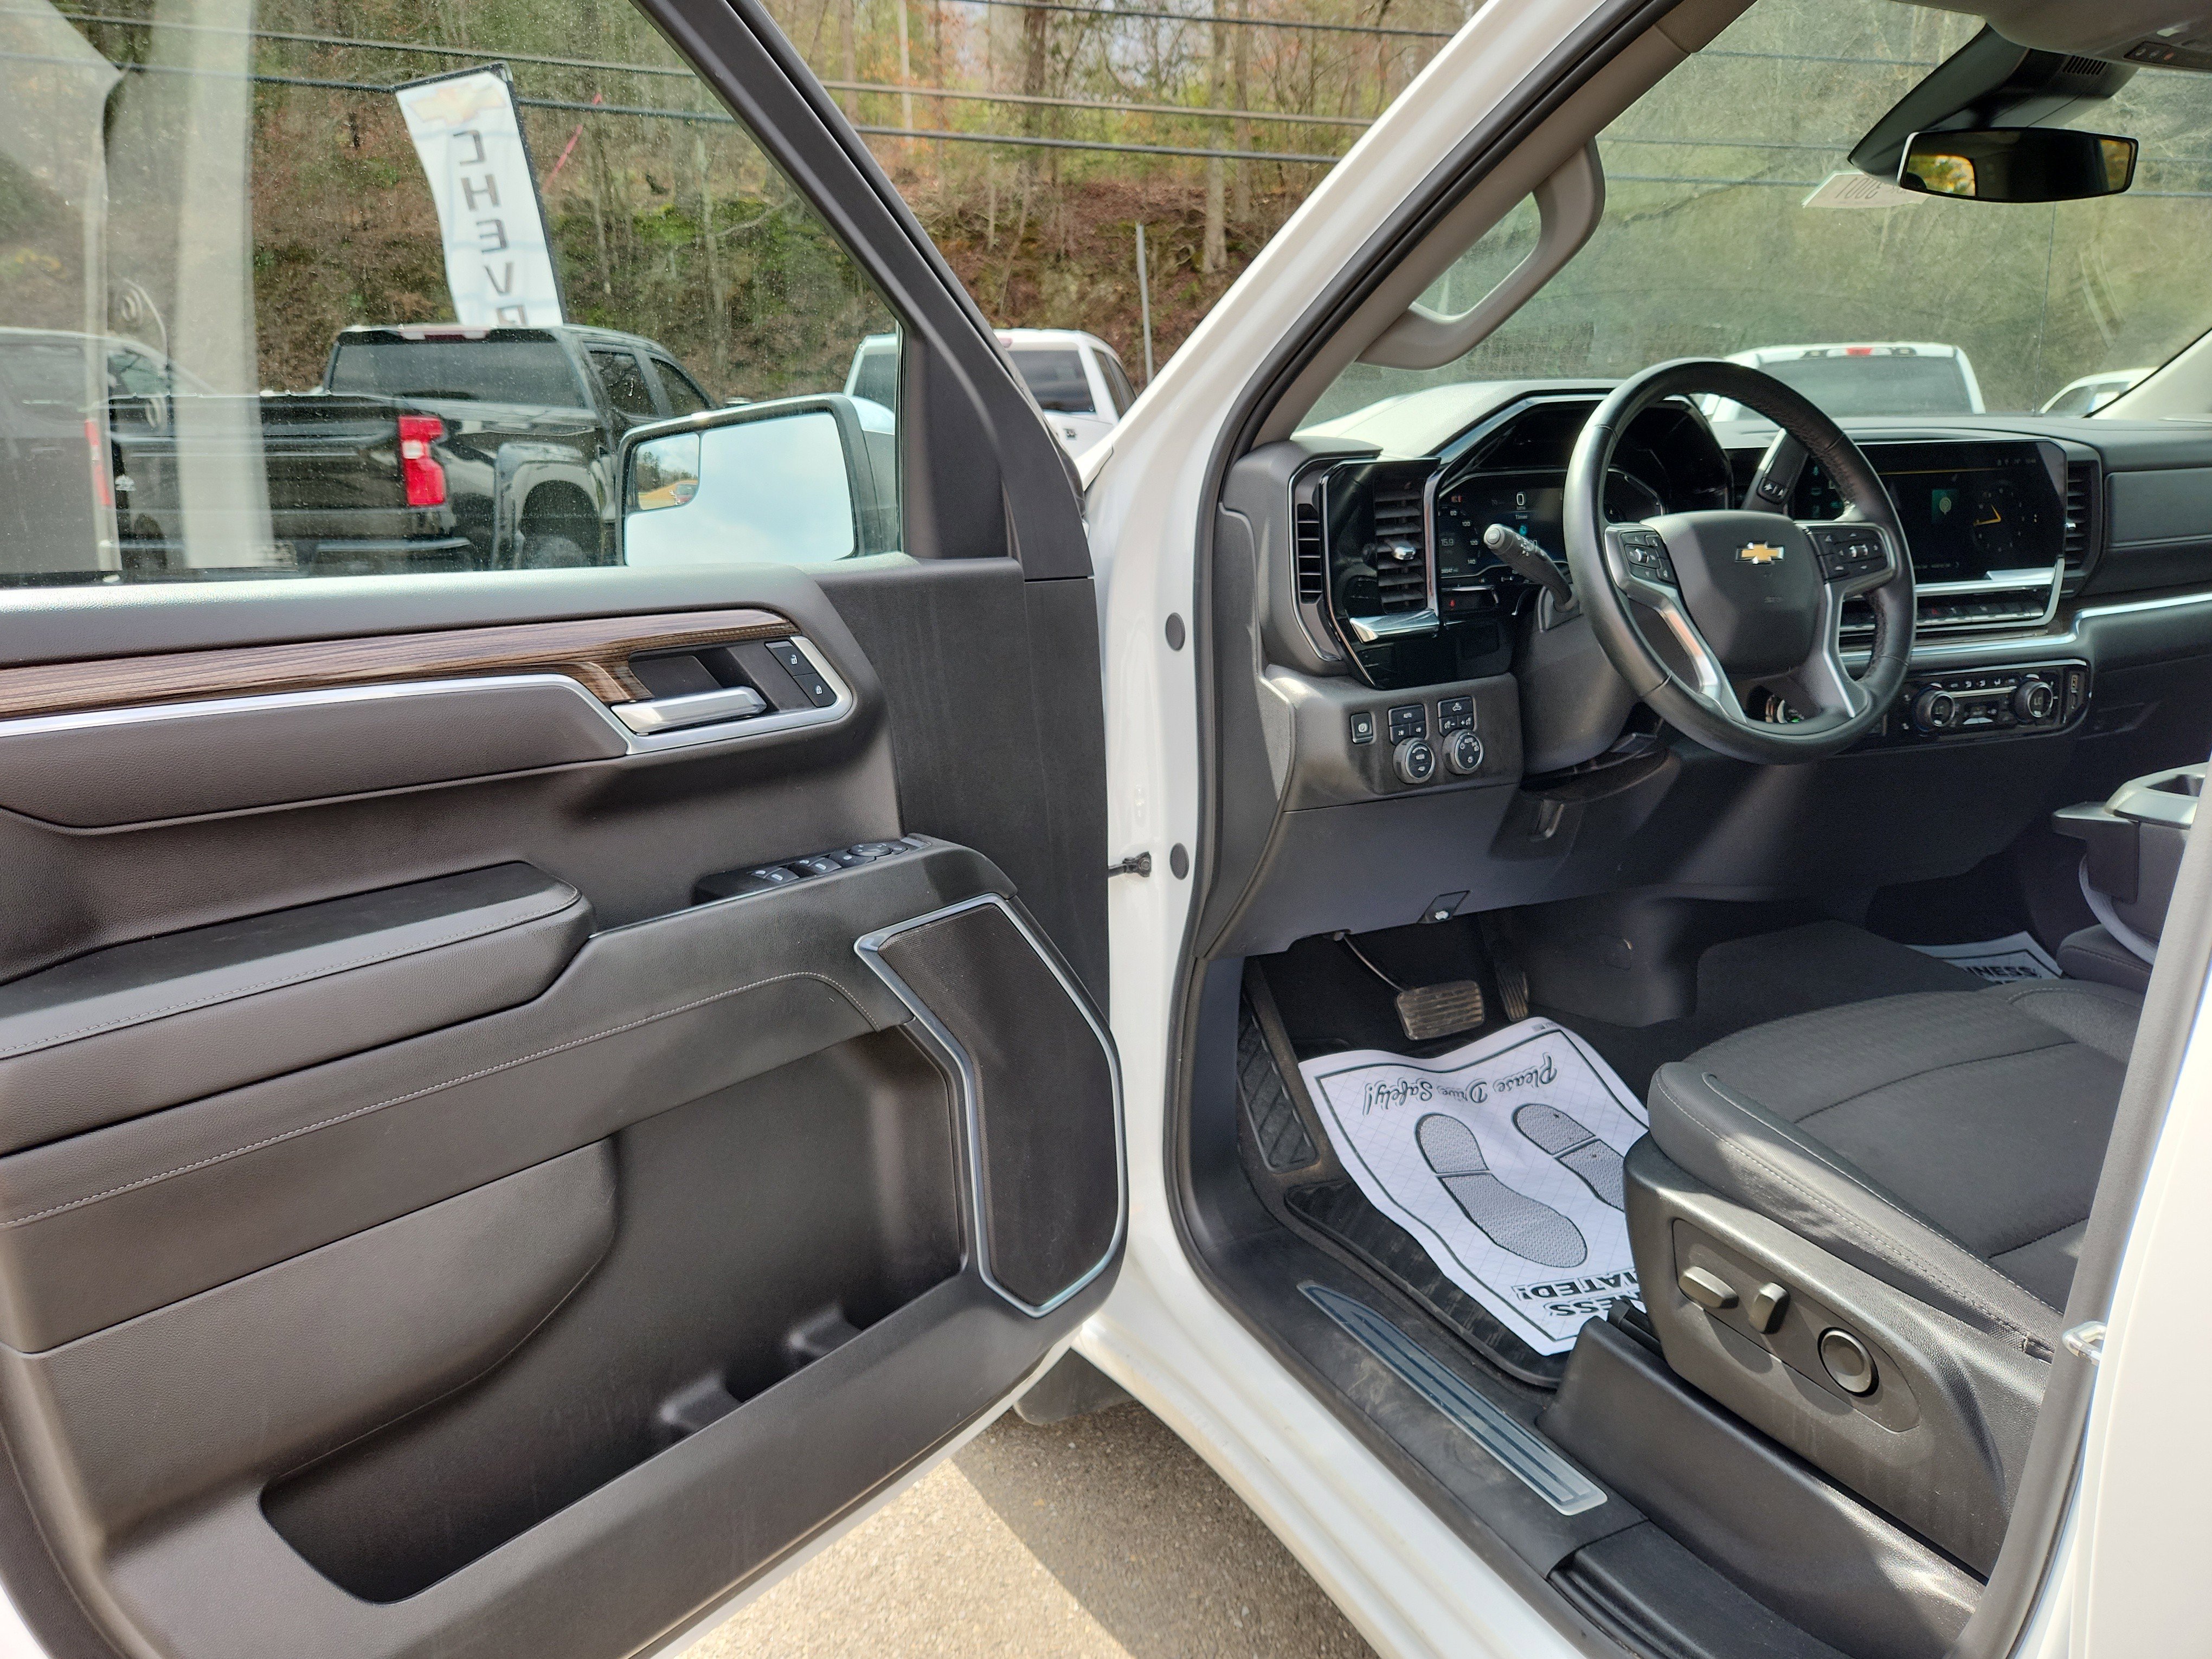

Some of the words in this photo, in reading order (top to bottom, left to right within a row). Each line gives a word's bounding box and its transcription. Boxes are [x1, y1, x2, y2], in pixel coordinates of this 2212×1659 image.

[1493, 1052, 1557, 1092] Please
[1363, 1078, 1433, 1115] Safely!
[1440, 1081, 1488, 1103] Drive
